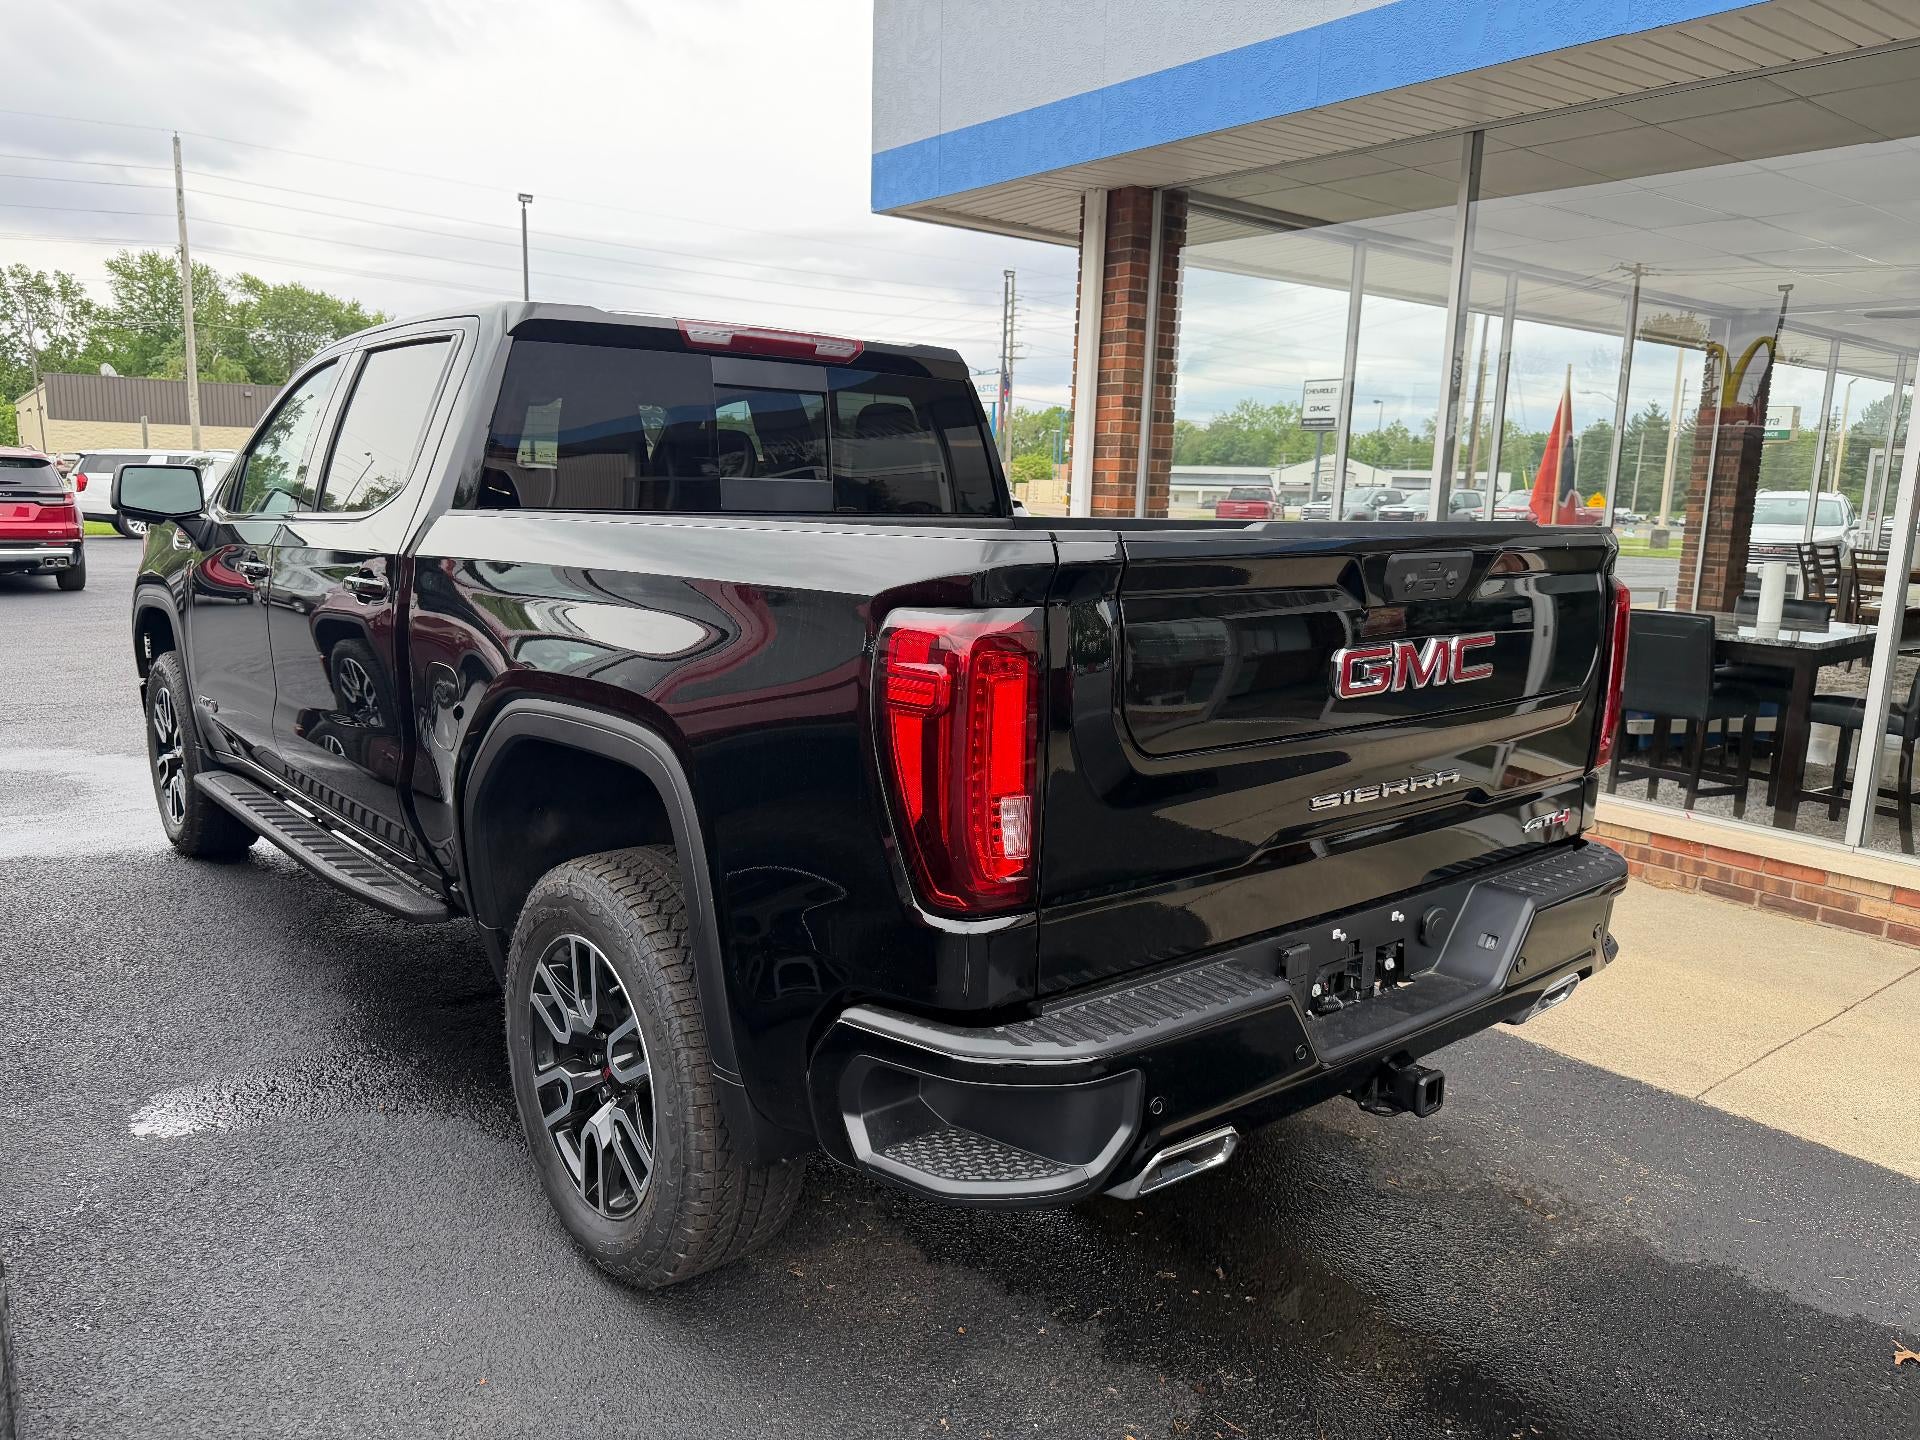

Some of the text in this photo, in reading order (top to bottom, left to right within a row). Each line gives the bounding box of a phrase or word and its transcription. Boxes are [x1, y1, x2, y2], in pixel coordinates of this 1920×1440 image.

[1305, 387, 1337, 395] CHEVROLET
[1330, 631, 1496, 701] GMC
[1309, 767, 1461, 812] SIERRA
[1521, 807, 1571, 834] AT4
